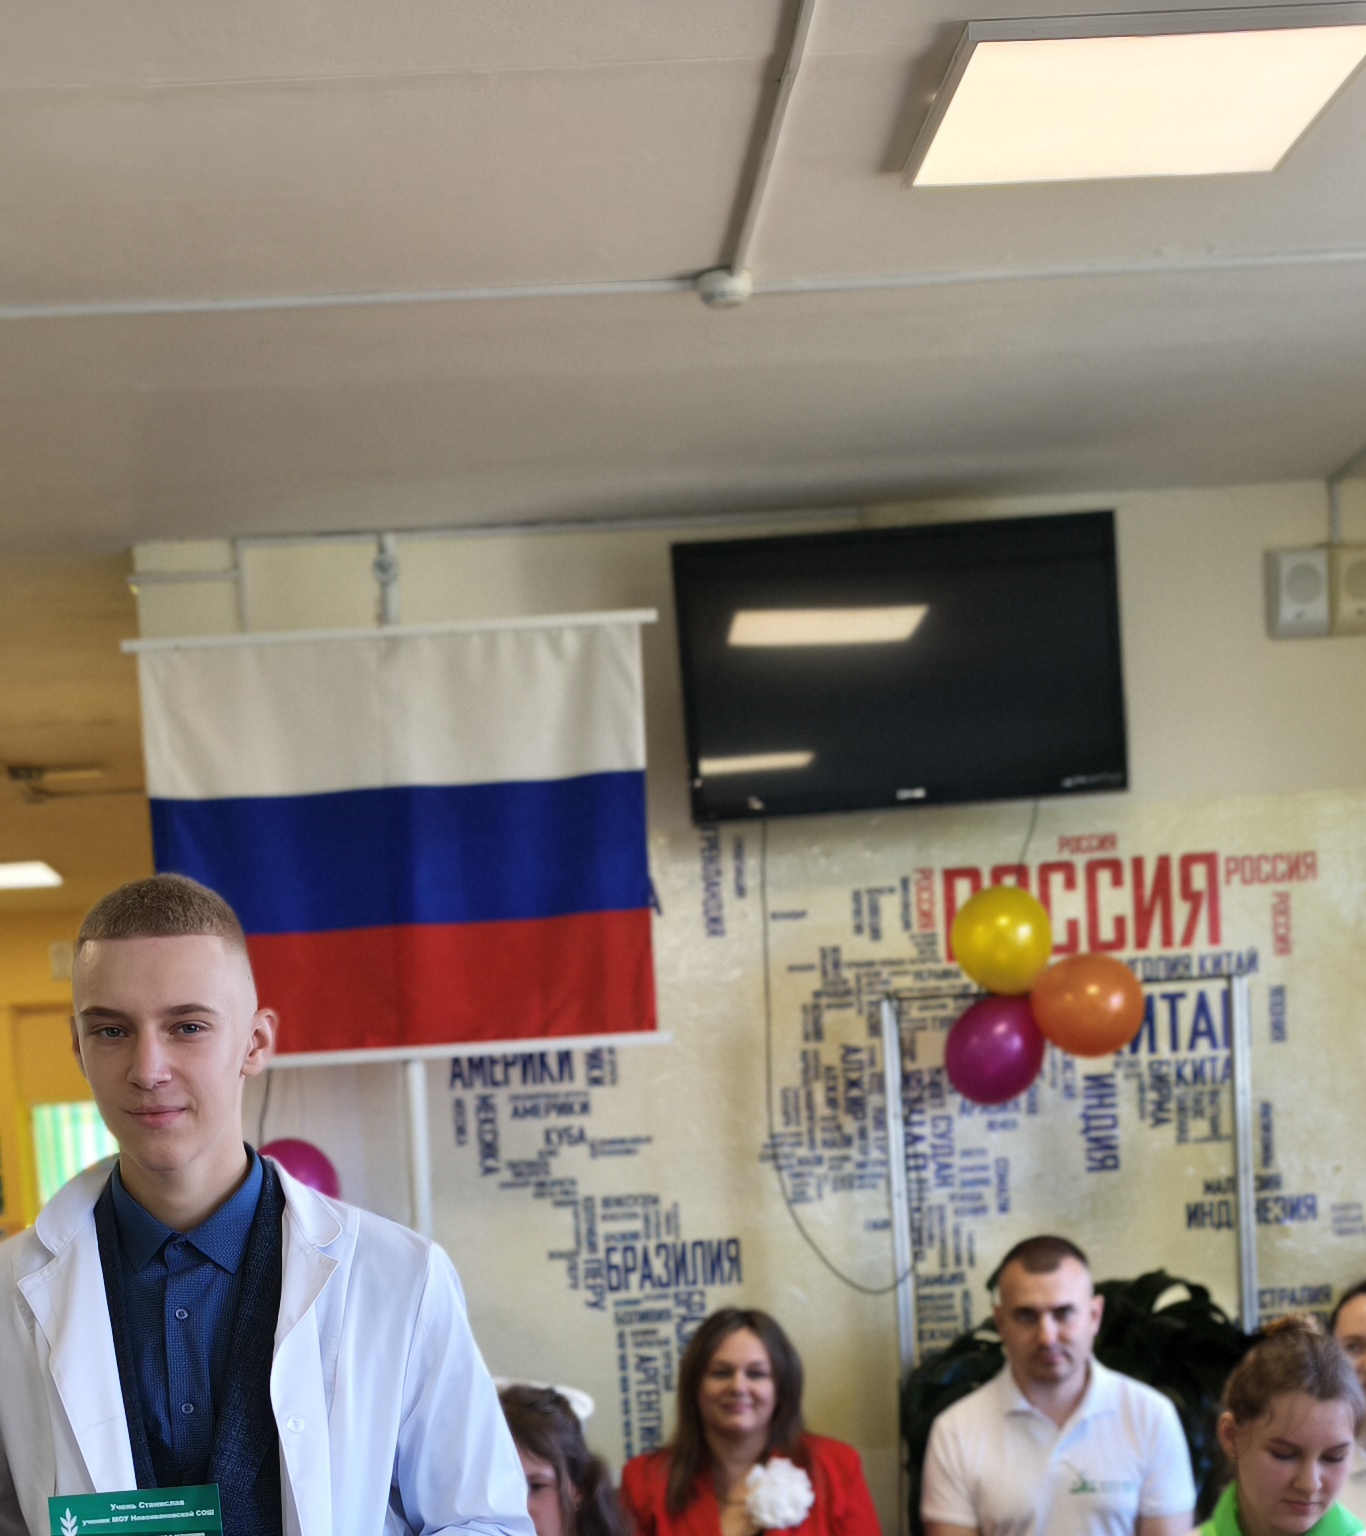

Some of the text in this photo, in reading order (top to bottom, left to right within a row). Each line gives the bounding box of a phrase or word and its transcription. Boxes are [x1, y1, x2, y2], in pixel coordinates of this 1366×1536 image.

[1225, 850, 1318, 886] РОССИЯ
[943, 852, 1222, 963] РССИЯ
[1271, 891, 1292, 956] РОССИЯ
[1198, 947, 1259, 978] КИТАЙ
[1129, 988, 1231, 1055] ИТА
[449, 1050, 575, 1090] АМЕРИКИ
[840, 1043, 867, 1122] АЛЖИР
[1148, 1060, 1172, 1129] БИРМА
[1175, 1055, 1232, 1088] КИТА
[476, 1094, 501, 1177] МЕКСИКА
[510, 1100, 591, 1120] АМЕРИКИ
[1079, 1072, 1120, 1173] ИНДИЯ
[544, 1126, 586, 1148] КУБА
[929, 1114, 955, 1188] СУДАН
[1203, 1173, 1283, 1196] МАЛЗИЯ
[1186, 1194, 1319, 1231] ИНДЕЗИЯ
[584, 1258, 606, 1311] ПЕРУ
[605, 1237, 743, 1293] БРАЗИЛИЯ
[1257, 1284, 1333, 1309] СТРАЛИЯ
[635, 1352, 664, 1451] АРГЕНТИН
[195, 1508, 215, 1516] СОШ
